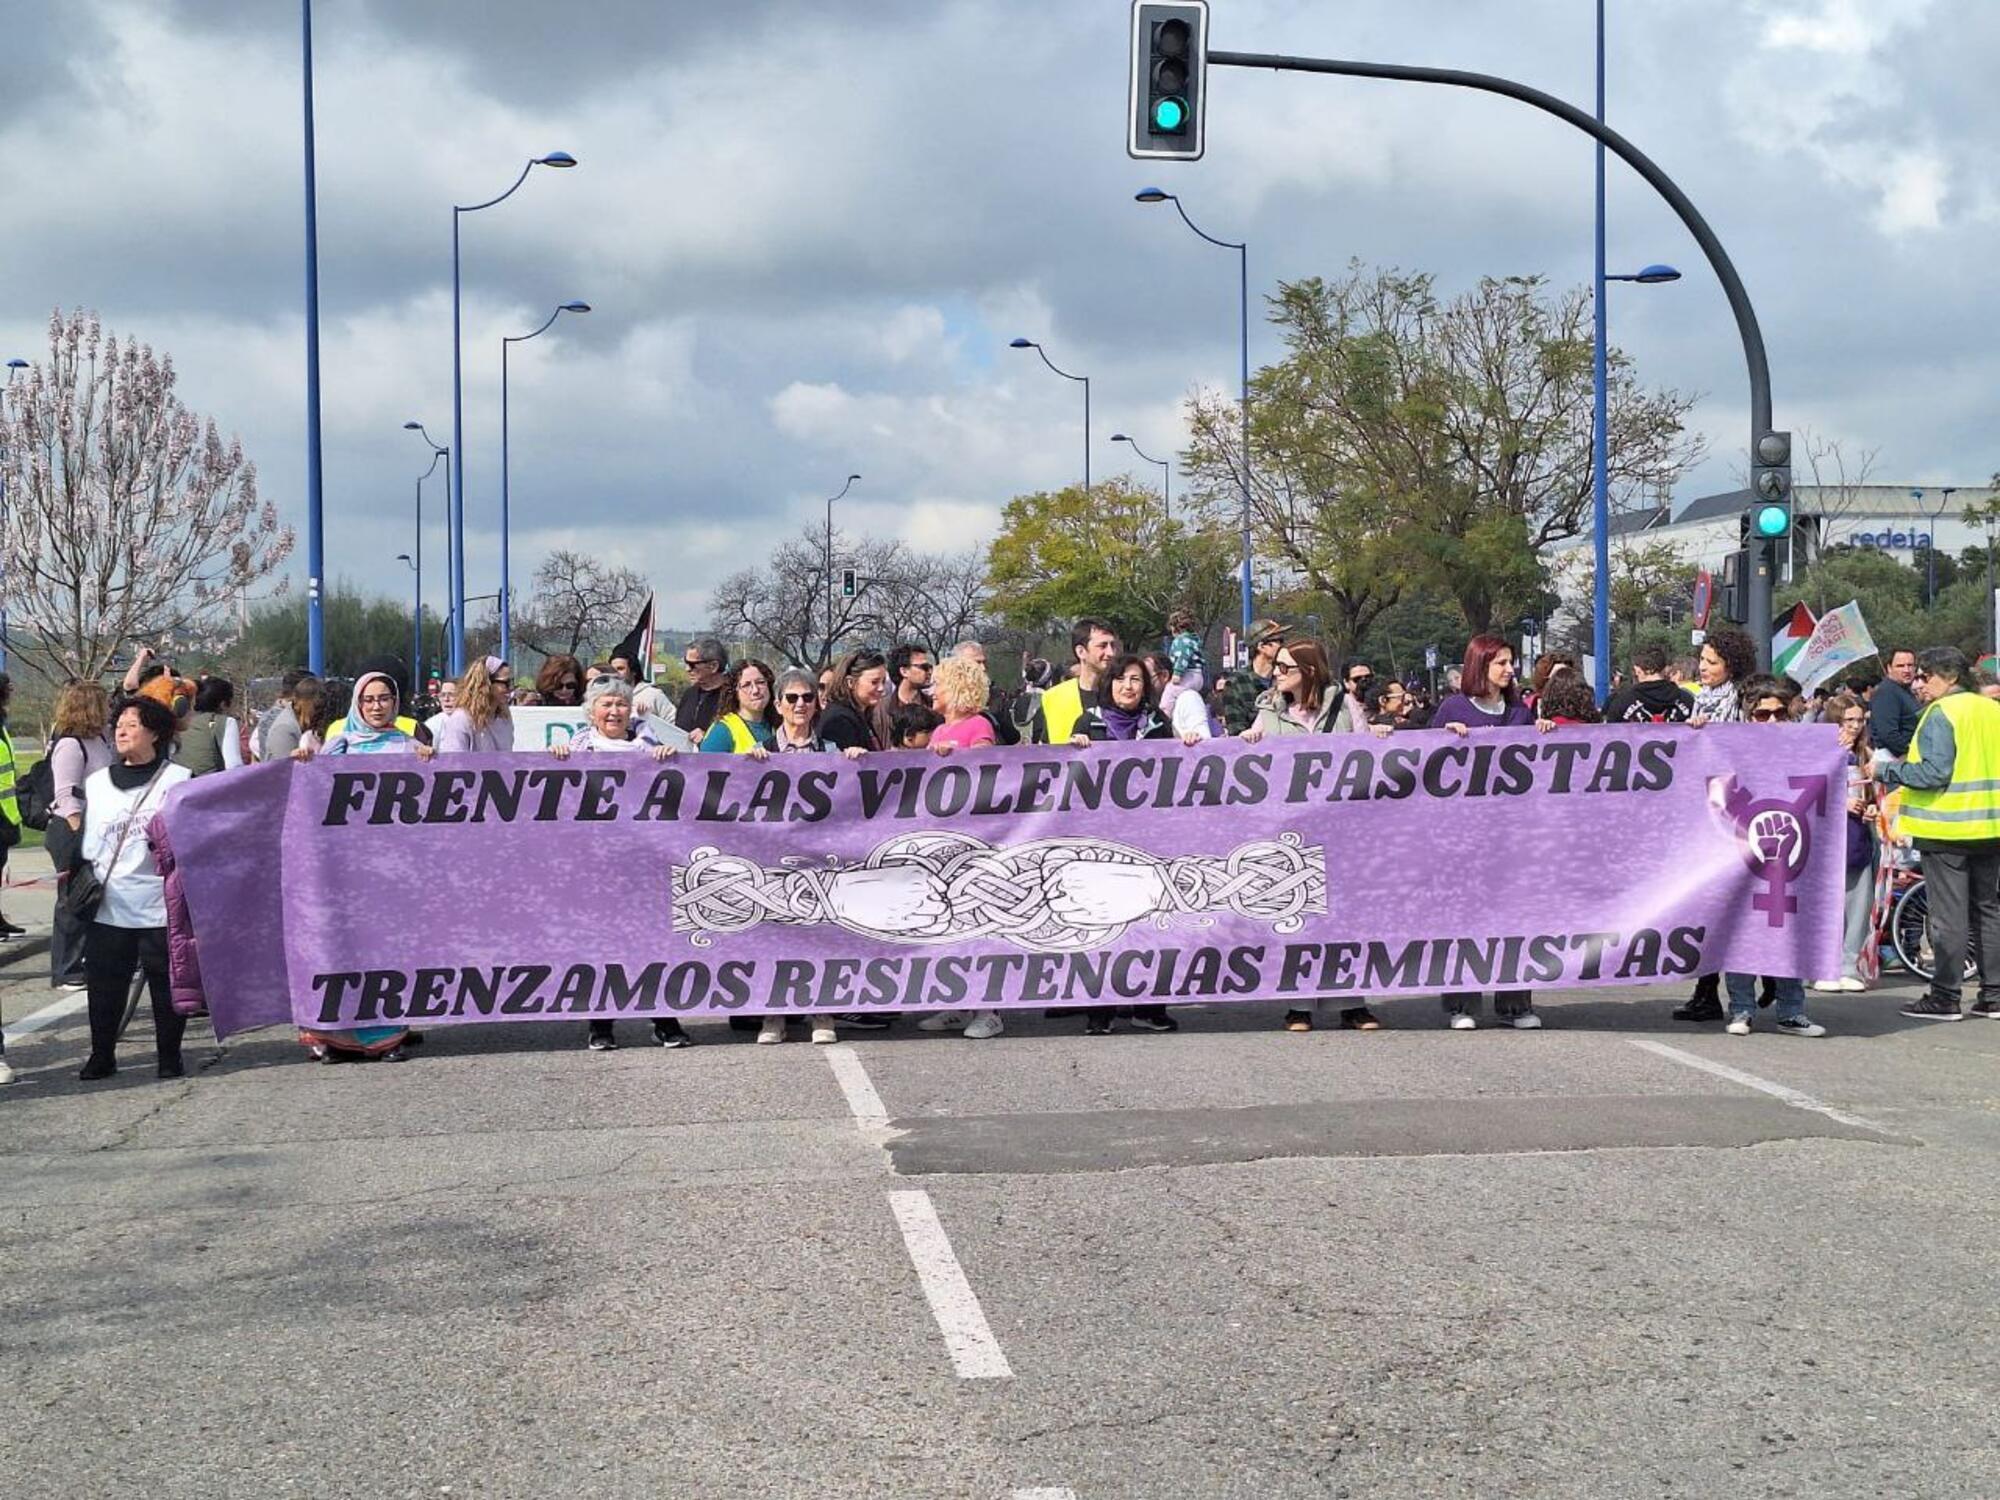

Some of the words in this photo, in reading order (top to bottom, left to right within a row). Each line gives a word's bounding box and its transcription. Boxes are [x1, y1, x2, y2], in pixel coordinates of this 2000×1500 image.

[1850, 527, 1931, 549] redeia
[322, 770, 627, 825] FRENTE
[633, 769, 686, 822] A
[696, 770, 838, 822] LAS
[857, 754, 1272, 819] VIOLENCIAS
[1285, 740, 1677, 803] FASCISTAS
[312, 961, 755, 1022] TRENZAMOS
[765, 945, 1265, 1008] RESISTENCIAS
[1277, 926, 1706, 992] FEMINISTAS
